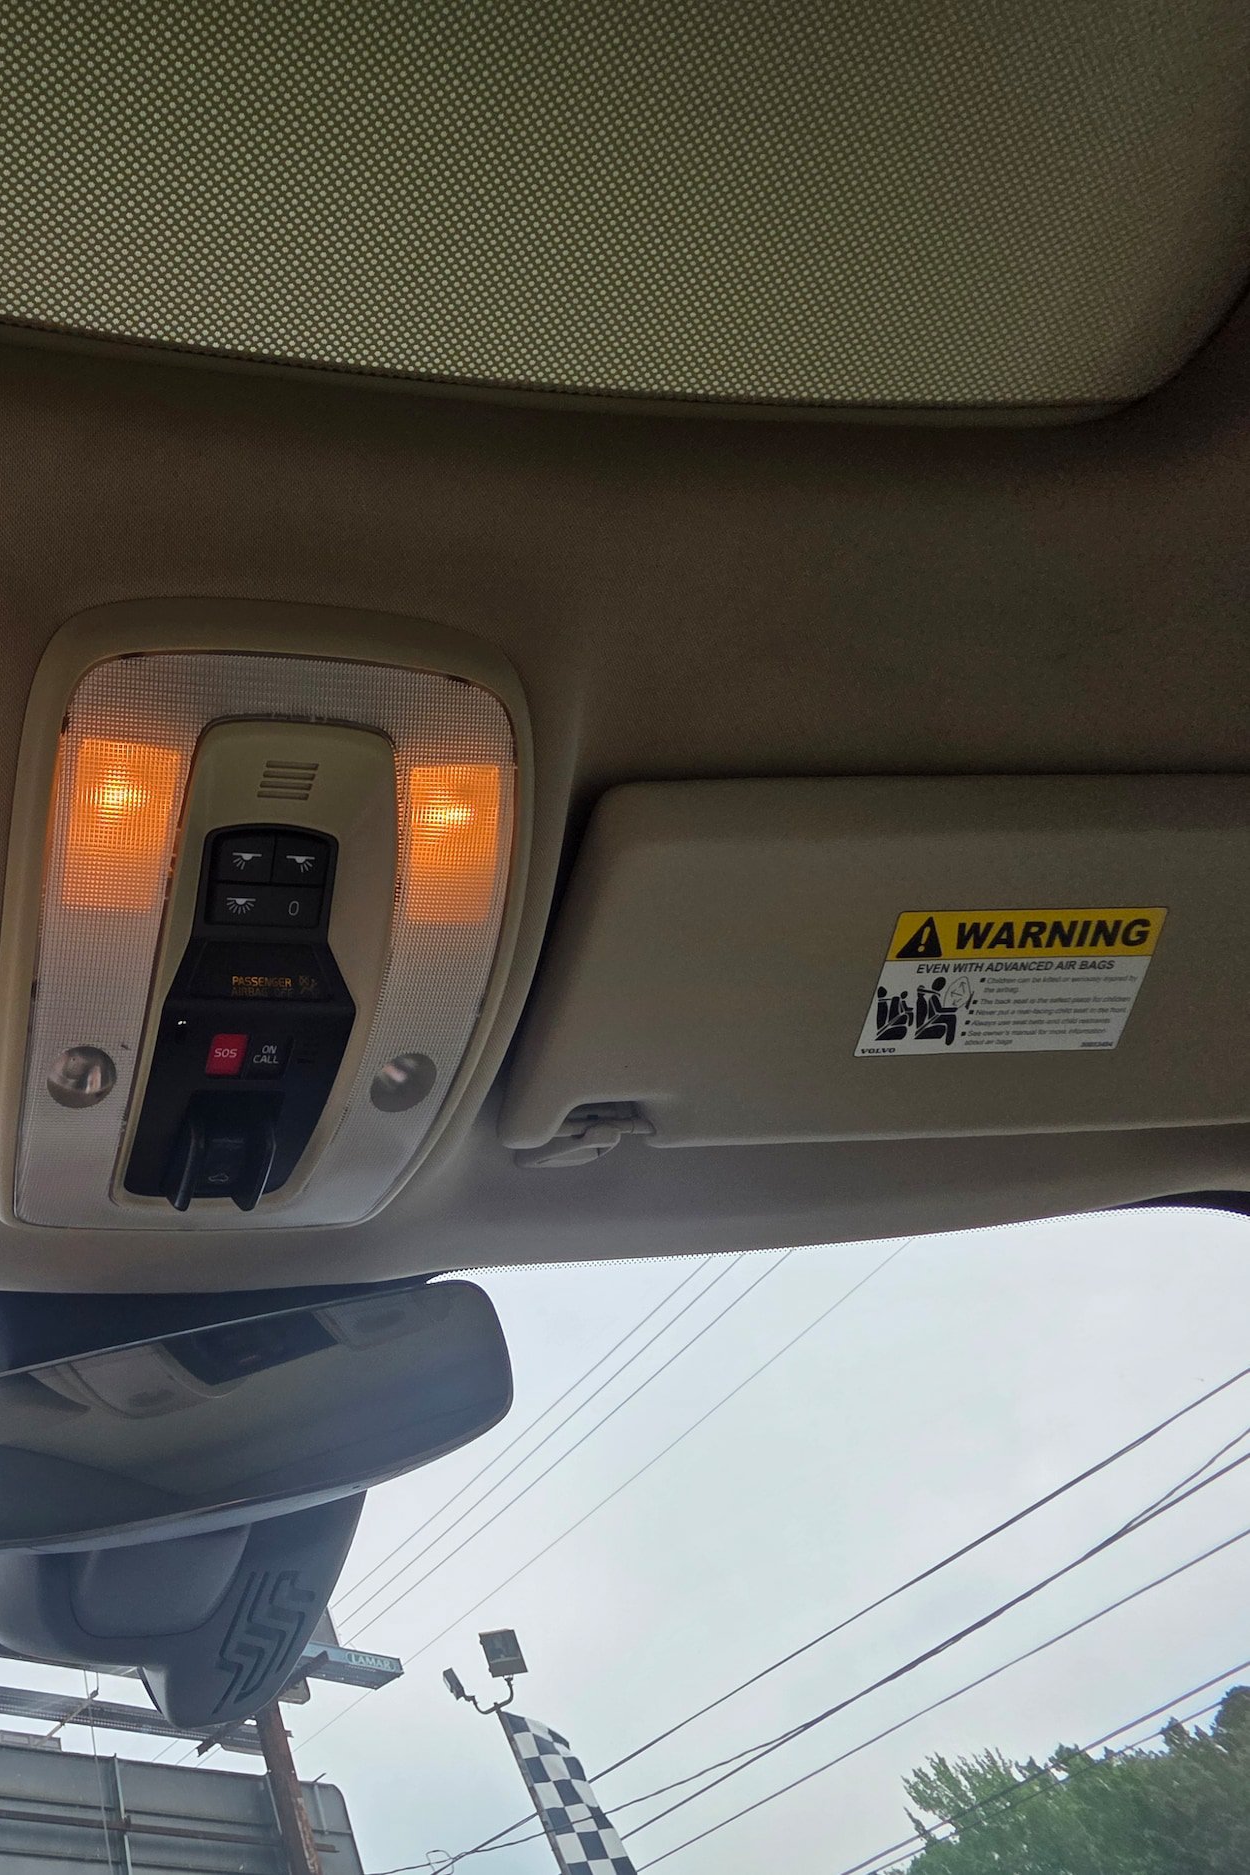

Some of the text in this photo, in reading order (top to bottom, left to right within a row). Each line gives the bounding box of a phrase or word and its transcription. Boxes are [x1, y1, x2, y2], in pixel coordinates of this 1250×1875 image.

[955, 918, 1151, 950] WARNING
[916, 960, 1115, 974] EVEN WITH ADVANCED AIR BAGS
[232, 975, 292, 988] PASSENGER
[213, 1047, 238, 1058] SOS
[262, 1045, 277, 1054] ON
[252, 1054, 279, 1064] CALL
[351, 1654, 391, 1670] LAMAR
